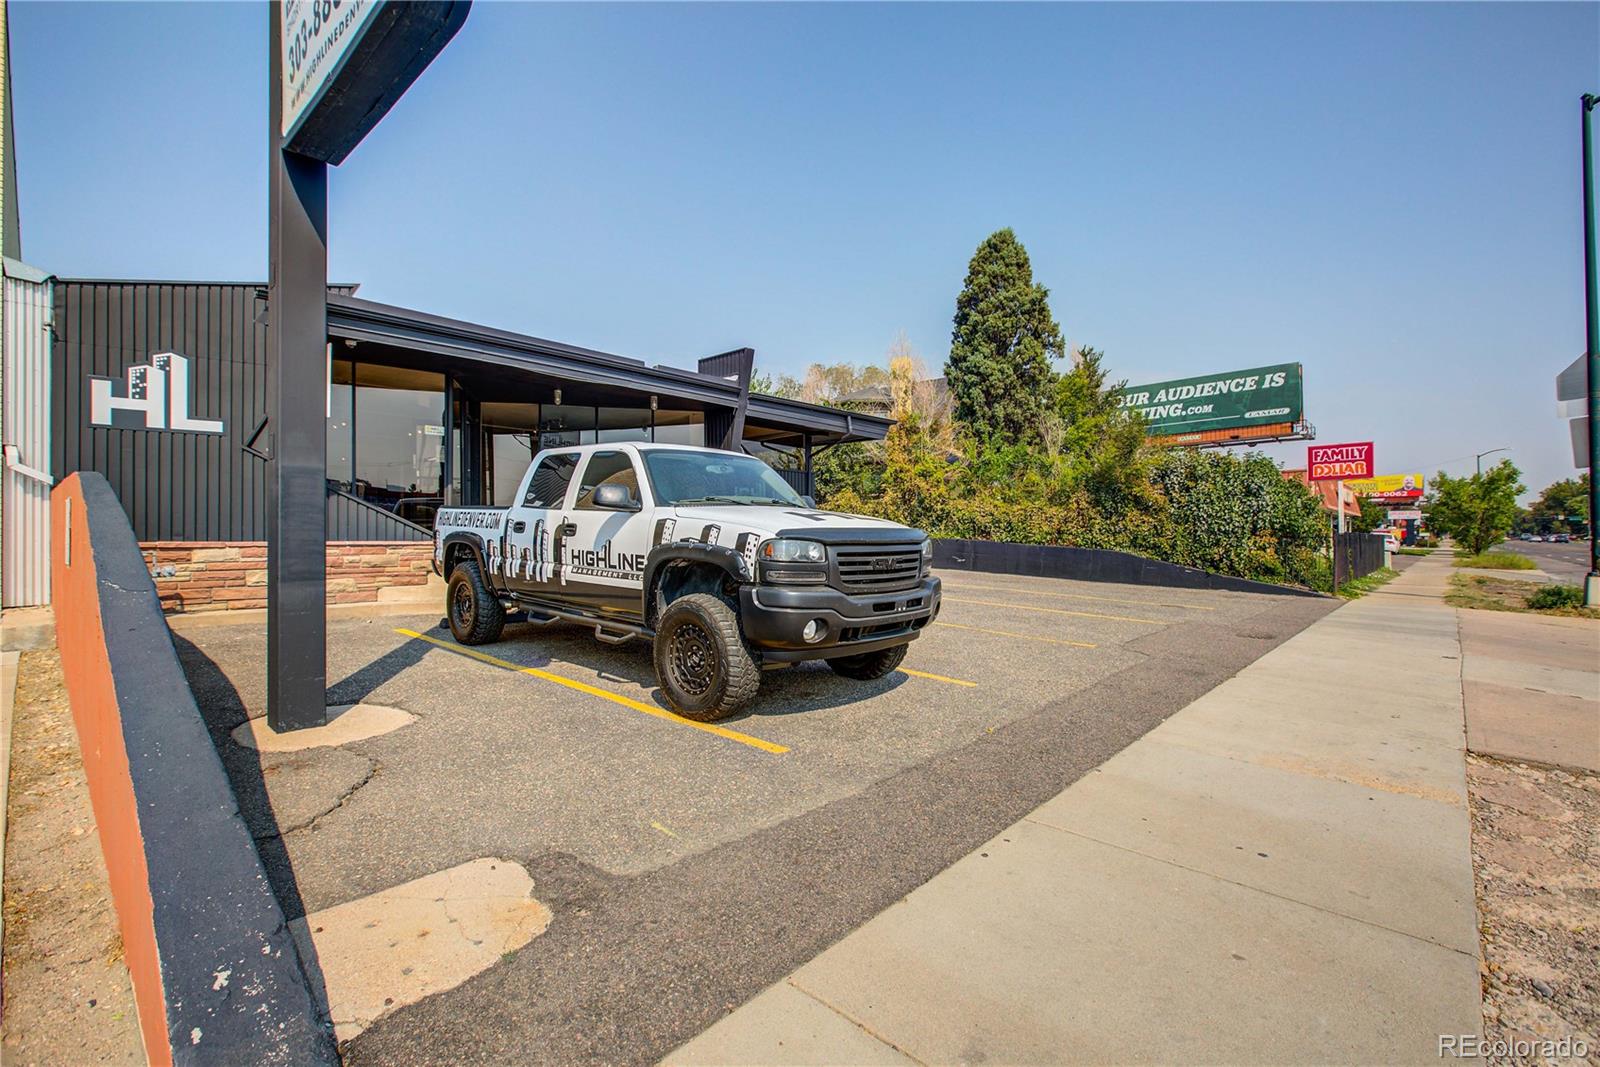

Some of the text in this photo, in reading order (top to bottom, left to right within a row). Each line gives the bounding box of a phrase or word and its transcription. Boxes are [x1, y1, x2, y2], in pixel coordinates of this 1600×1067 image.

[289, 0, 341, 84] 303-88
[91, 352, 223, 432] HL
[1153, 375, 1259, 403] AUDIENCE
[1262, 372, 1287, 389] IS
[1312, 445, 1368, 462] FAMILY
[1312, 461, 1367, 478] DOLLAR
[571, 539, 646, 572] HIGHLINE
[572, 567, 623, 579] MANAGEMENT
